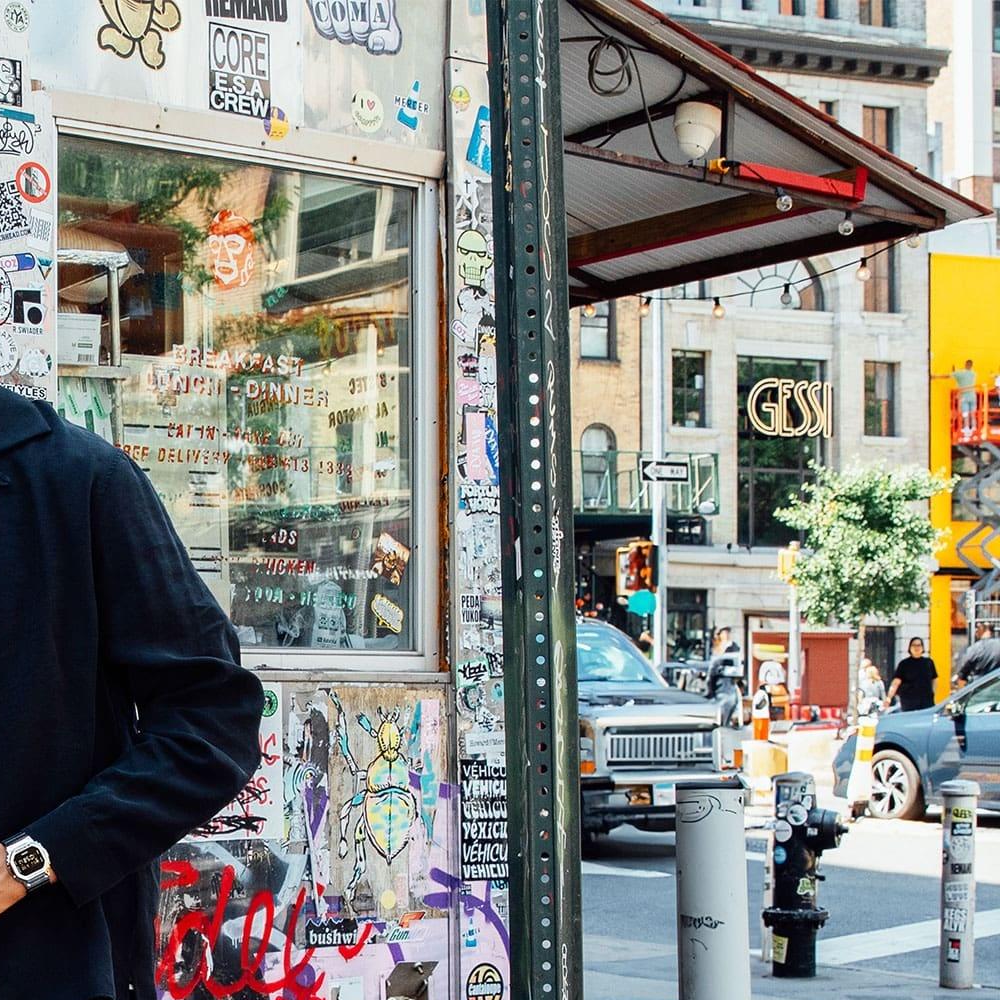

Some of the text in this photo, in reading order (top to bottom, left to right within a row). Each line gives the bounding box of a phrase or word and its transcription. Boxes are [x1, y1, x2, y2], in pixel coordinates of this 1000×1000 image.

[315, 1, 387, 24] COMA
[212, 27, 267, 78] CORE
[210, 90, 269, 118] CREW
[172, 343, 304, 377] BREAKFAST
[246, 379, 329, 408] DINNER
[747, 377, 834, 440] GESSI
[462, 595, 480, 608] PEDA
[462, 610, 480, 623] YUKO
[309, 927, 374, 945] bushwik
